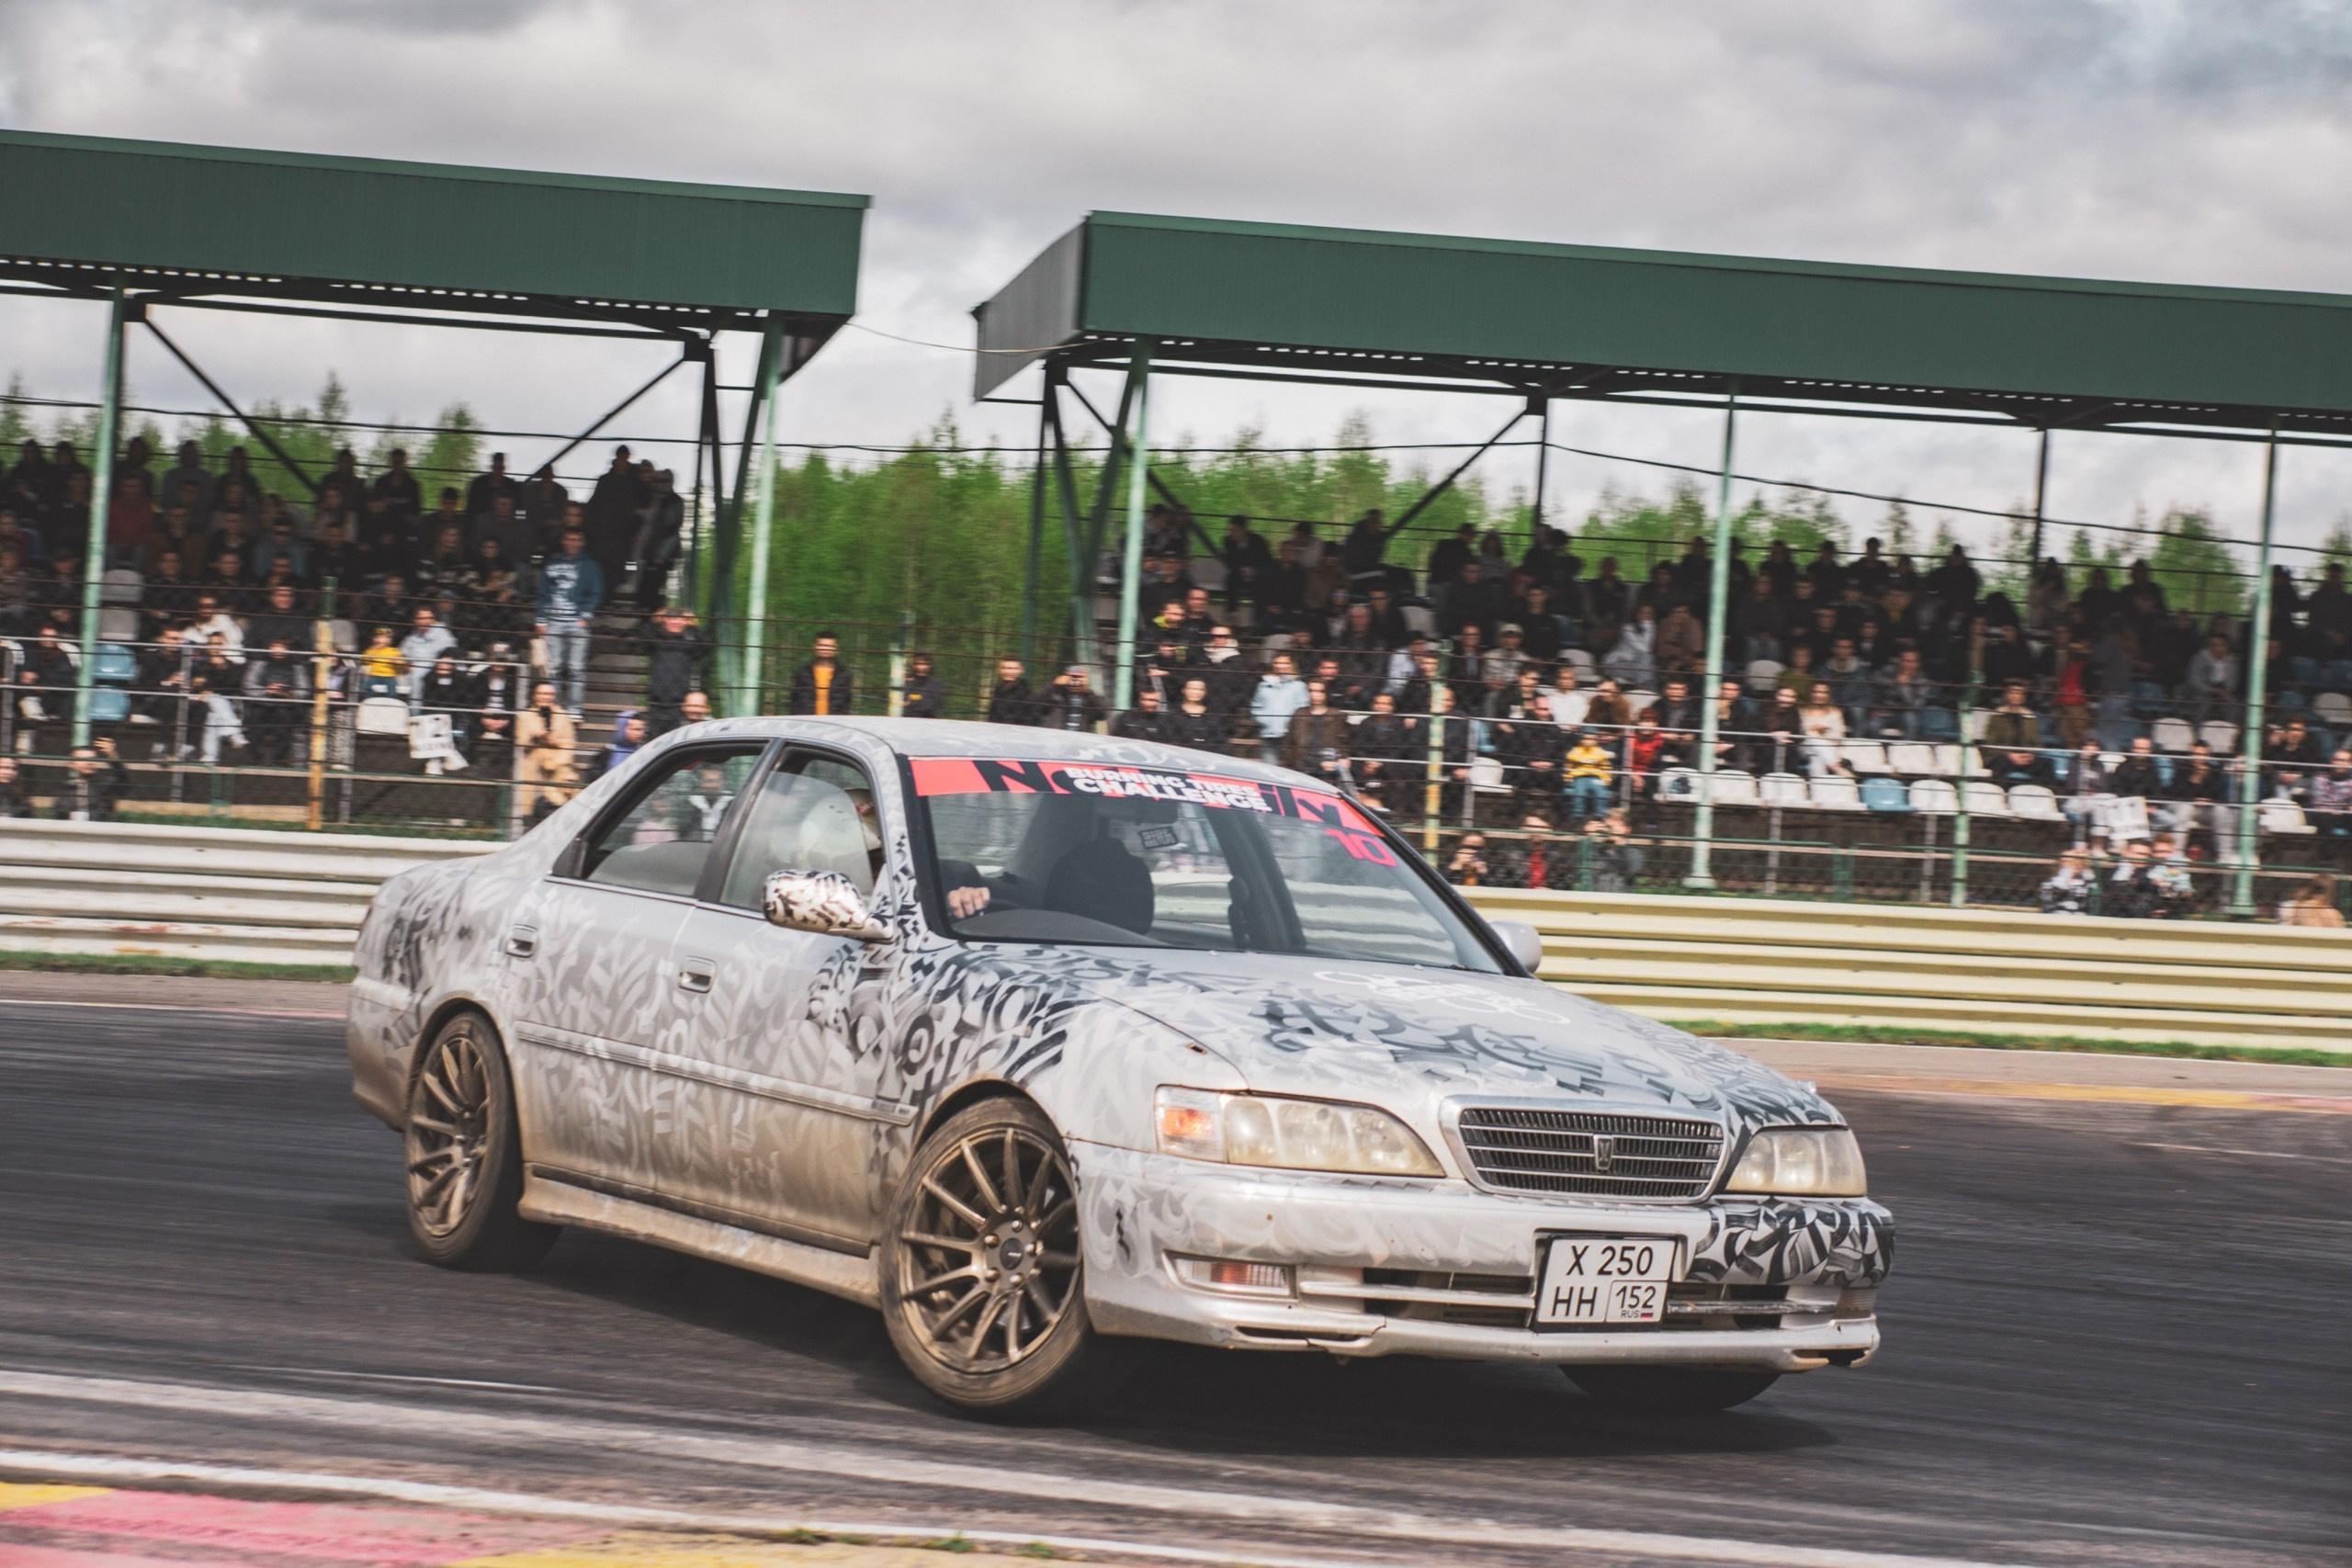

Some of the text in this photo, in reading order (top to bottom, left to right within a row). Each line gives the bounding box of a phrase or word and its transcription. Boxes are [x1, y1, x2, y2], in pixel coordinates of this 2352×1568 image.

[1064, 767, 1186, 788] BURNING
[1186, 778, 1260, 797] TIRES
[1073, 778, 1273, 812] CHALLENGE
[1324, 829, 1398, 867] 10
[1597, 1246, 1654, 1276] 250
[1615, 1286, 1657, 1309] 152
[1620, 1310, 1640, 1318] RUS
